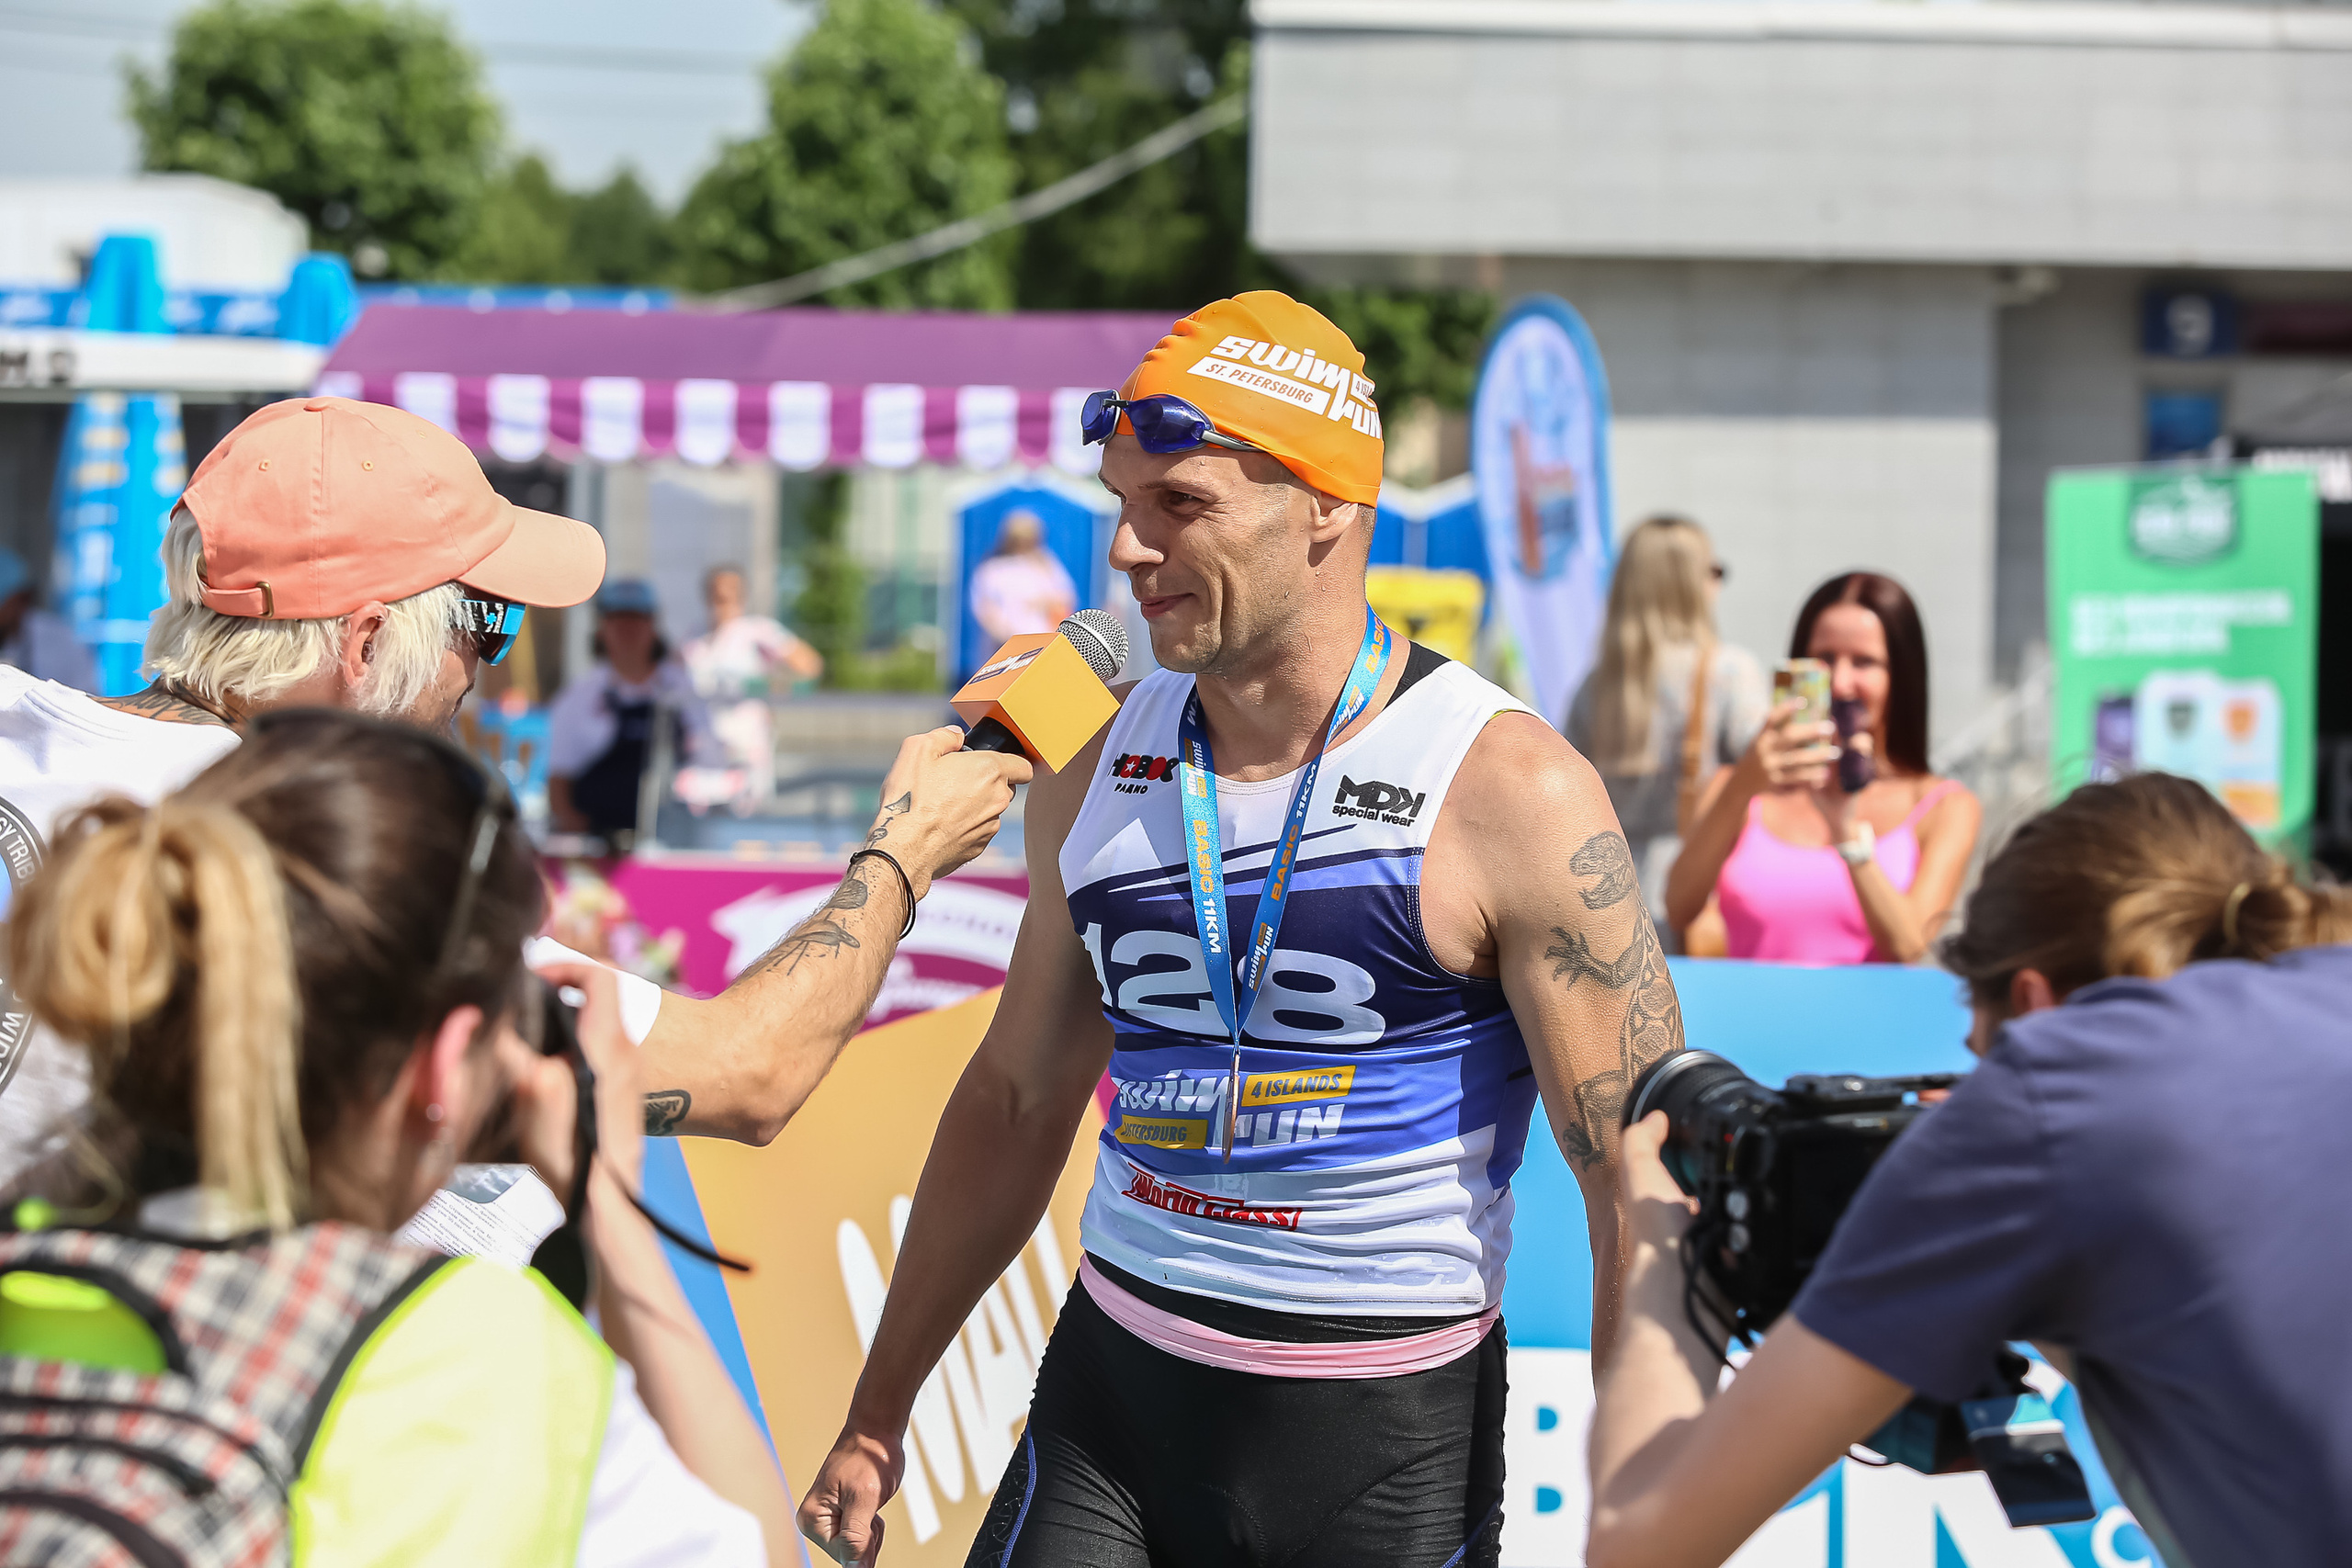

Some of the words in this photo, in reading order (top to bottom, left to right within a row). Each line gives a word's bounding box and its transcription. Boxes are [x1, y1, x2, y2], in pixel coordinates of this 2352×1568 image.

[1205, 363, 1227, 377] ST.
[1228, 368, 1314, 404] PETERSBURG
[1114, 784, 1148, 795] РАДИО
[1271, 824, 1299, 902] BASIC
[1295, 764, 1317, 819] 11KM
[1332, 806, 1379, 820] special
[1381, 813, 1415, 827] wear
[1193, 819, 1214, 893] BASIC
[1203, 897, 1222, 953] 11KM
[1080, 921, 1386, 1045] 128
[1250, 1079, 1261, 1099] 4
[1264, 1073, 1343, 1098] ISLANDS
